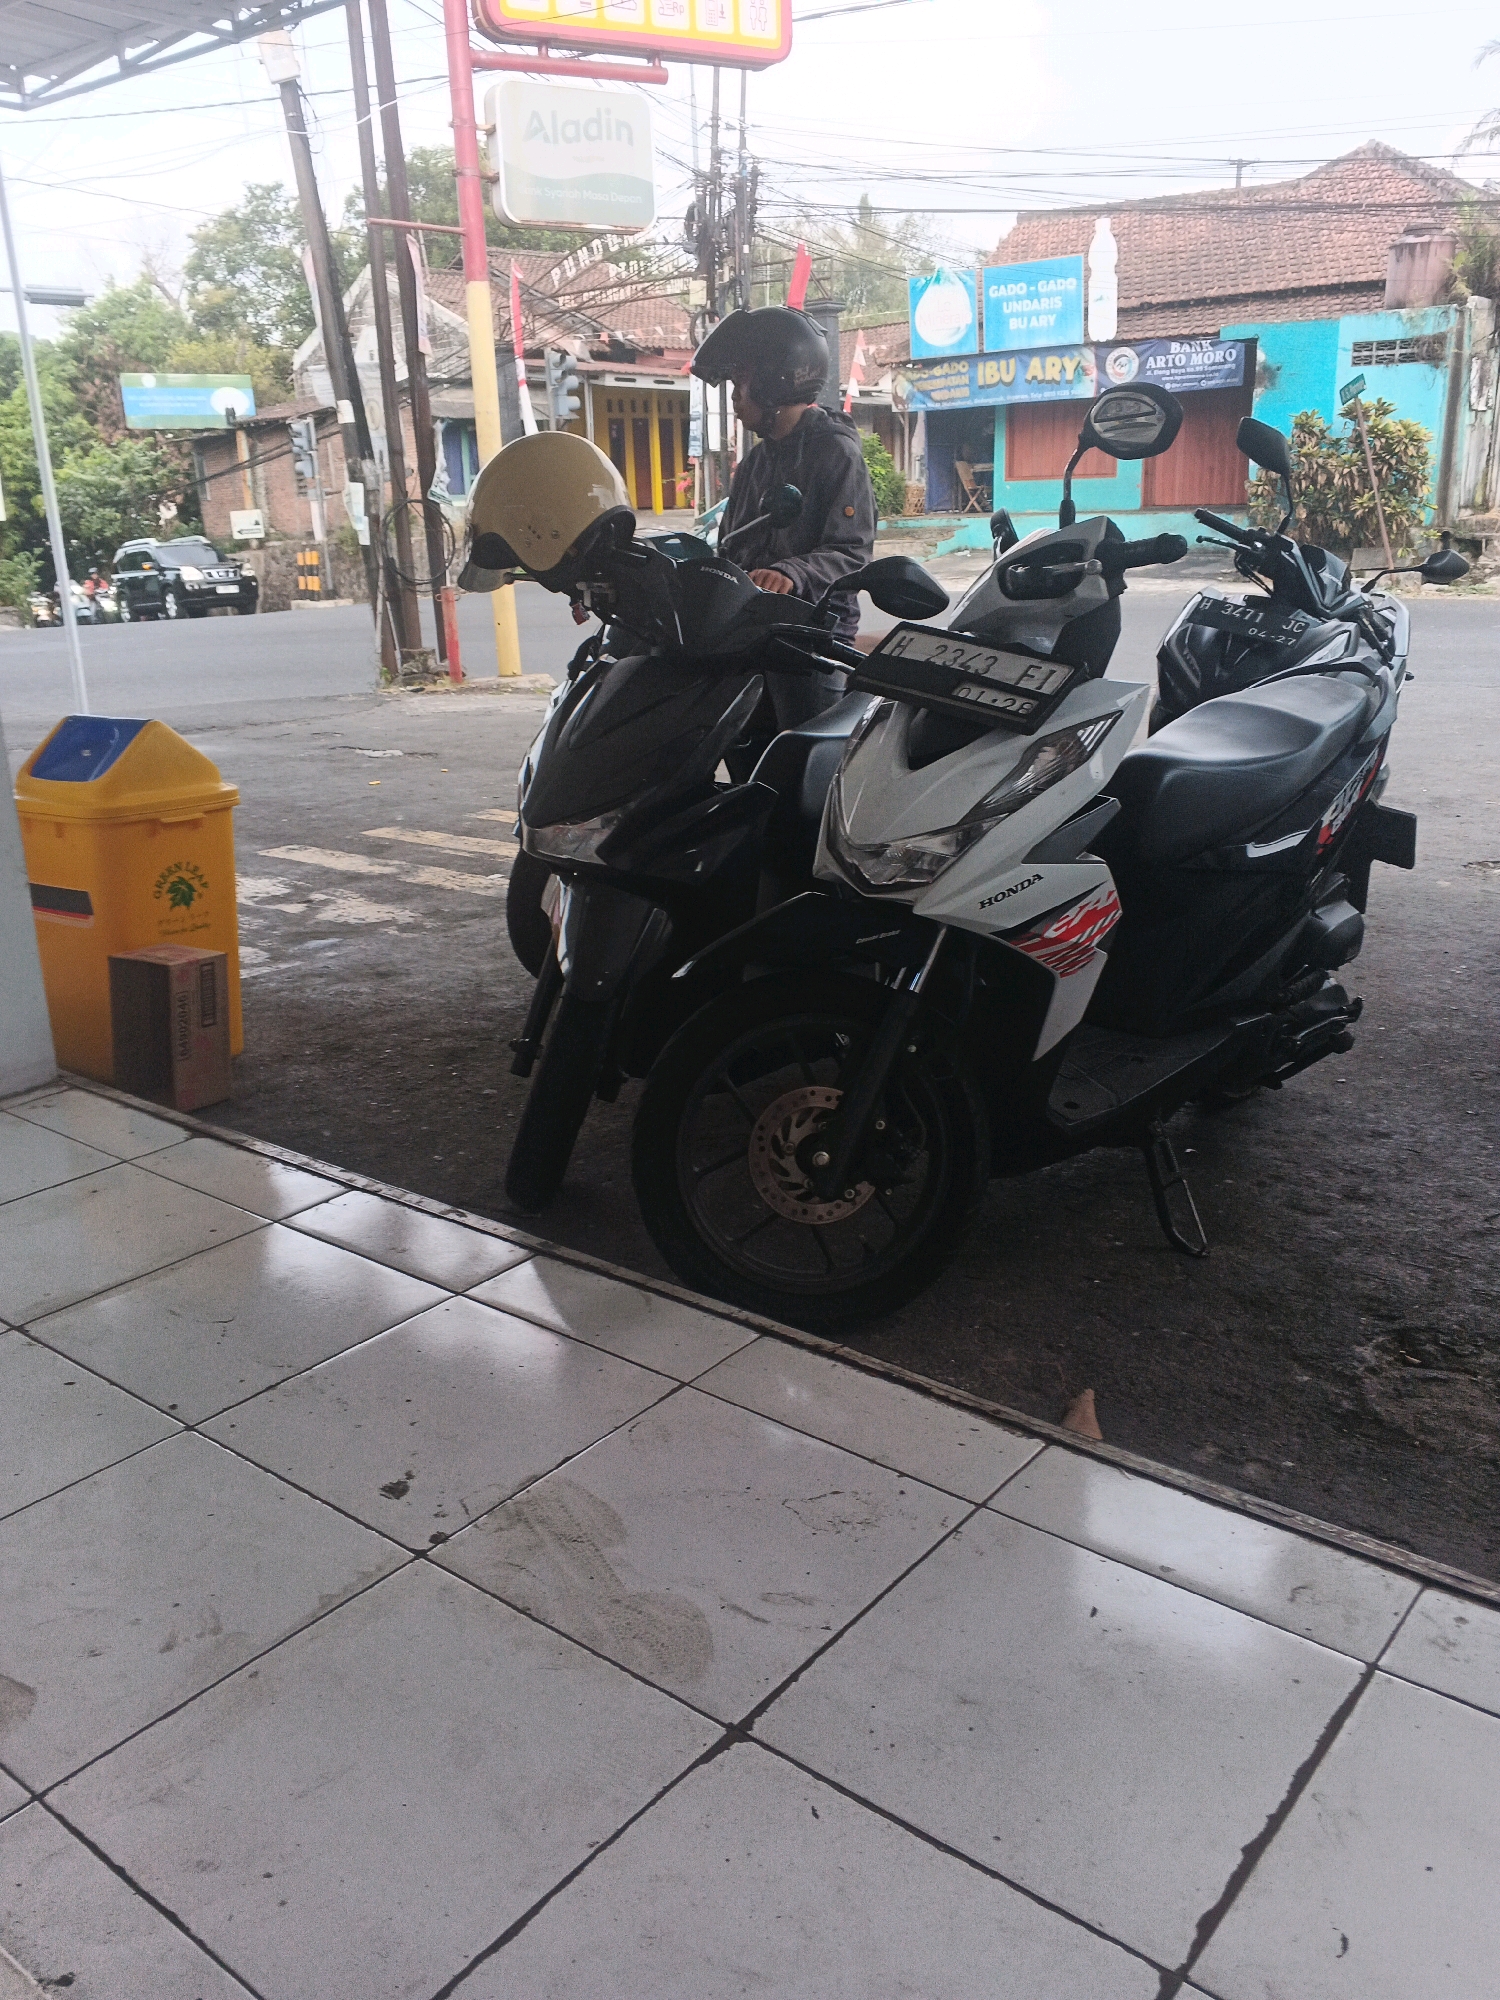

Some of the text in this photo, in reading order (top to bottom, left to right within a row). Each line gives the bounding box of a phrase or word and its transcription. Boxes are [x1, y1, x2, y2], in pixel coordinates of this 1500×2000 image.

[672, 1, 685, 15] Rp
[521, 107, 635, 148] Aladin
[583, 190, 610, 202] Masa
[611, 192, 643, 205] Depan
[989, 282, 1028, 298] GADO
[1037, 278, 1078, 293] GADO
[1003, 296, 1063, 314] UNDARIS
[1009, 314, 1057, 330] BU ARY
[1170, 340, 1213, 353] BANK
[1145, 354, 1187, 369] ARTO
[1190, 348, 1237, 365] MORO
[977, 358, 1017, 388] IBU
[1025, 355, 1081, 385] ARY
[700, 566, 739, 585] HONDA
[1199, 599, 1306, 634] H 3471 JC
[889, 635, 915, 658] H
[924, 644, 998, 677] 2343
[153, 861, 184, 900] GREEN
[978, 873, 1044, 910] HONDA
